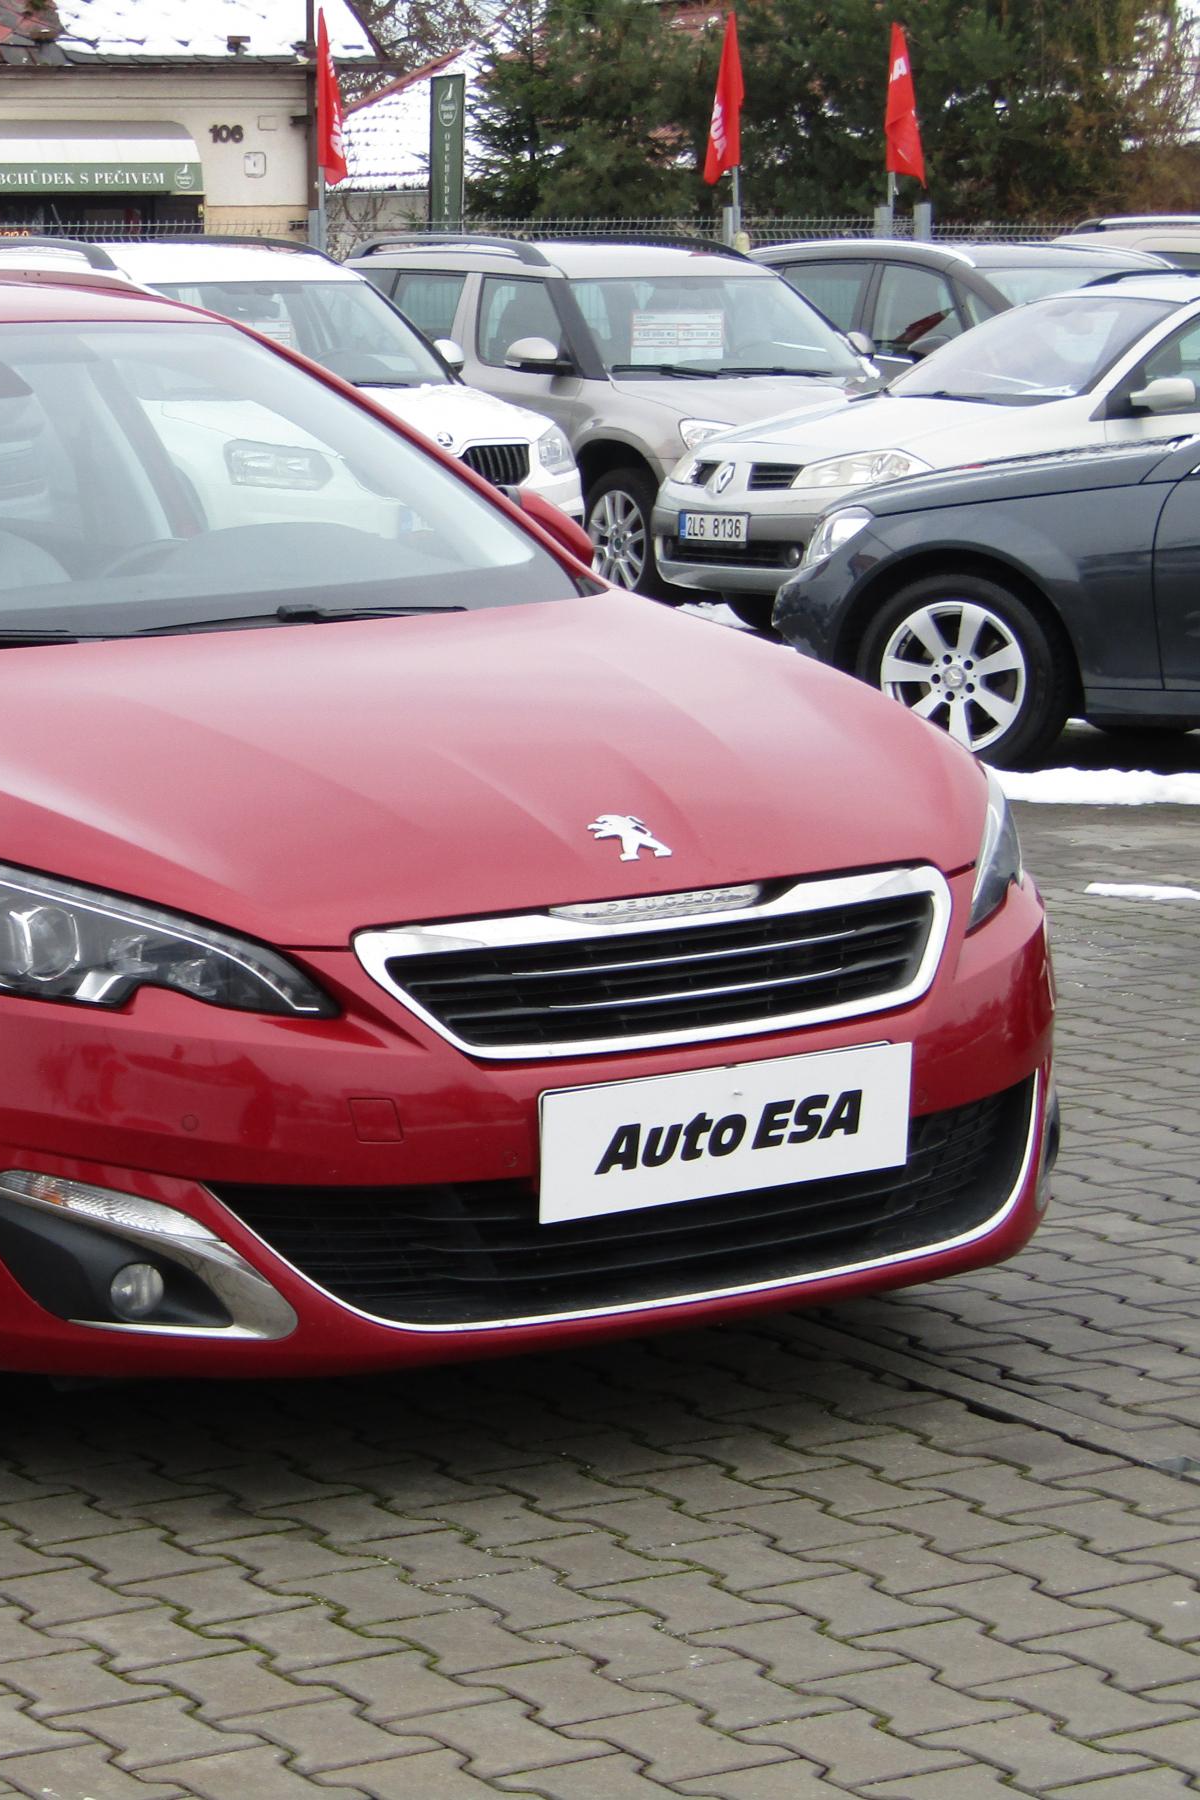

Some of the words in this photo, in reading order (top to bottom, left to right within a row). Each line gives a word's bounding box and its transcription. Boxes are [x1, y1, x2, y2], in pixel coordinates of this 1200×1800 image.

[208, 124, 244, 144] 106
[79, 172, 89, 185] S
[94, 169, 165, 185] PEČIVEM
[687, 516, 705, 537] 2L6
[712, 517, 741, 538] 8136
[606, 889, 739, 912] PEUGEOT
[593, 1112, 747, 1176] Auto
[751, 1088, 863, 1150] ESA
